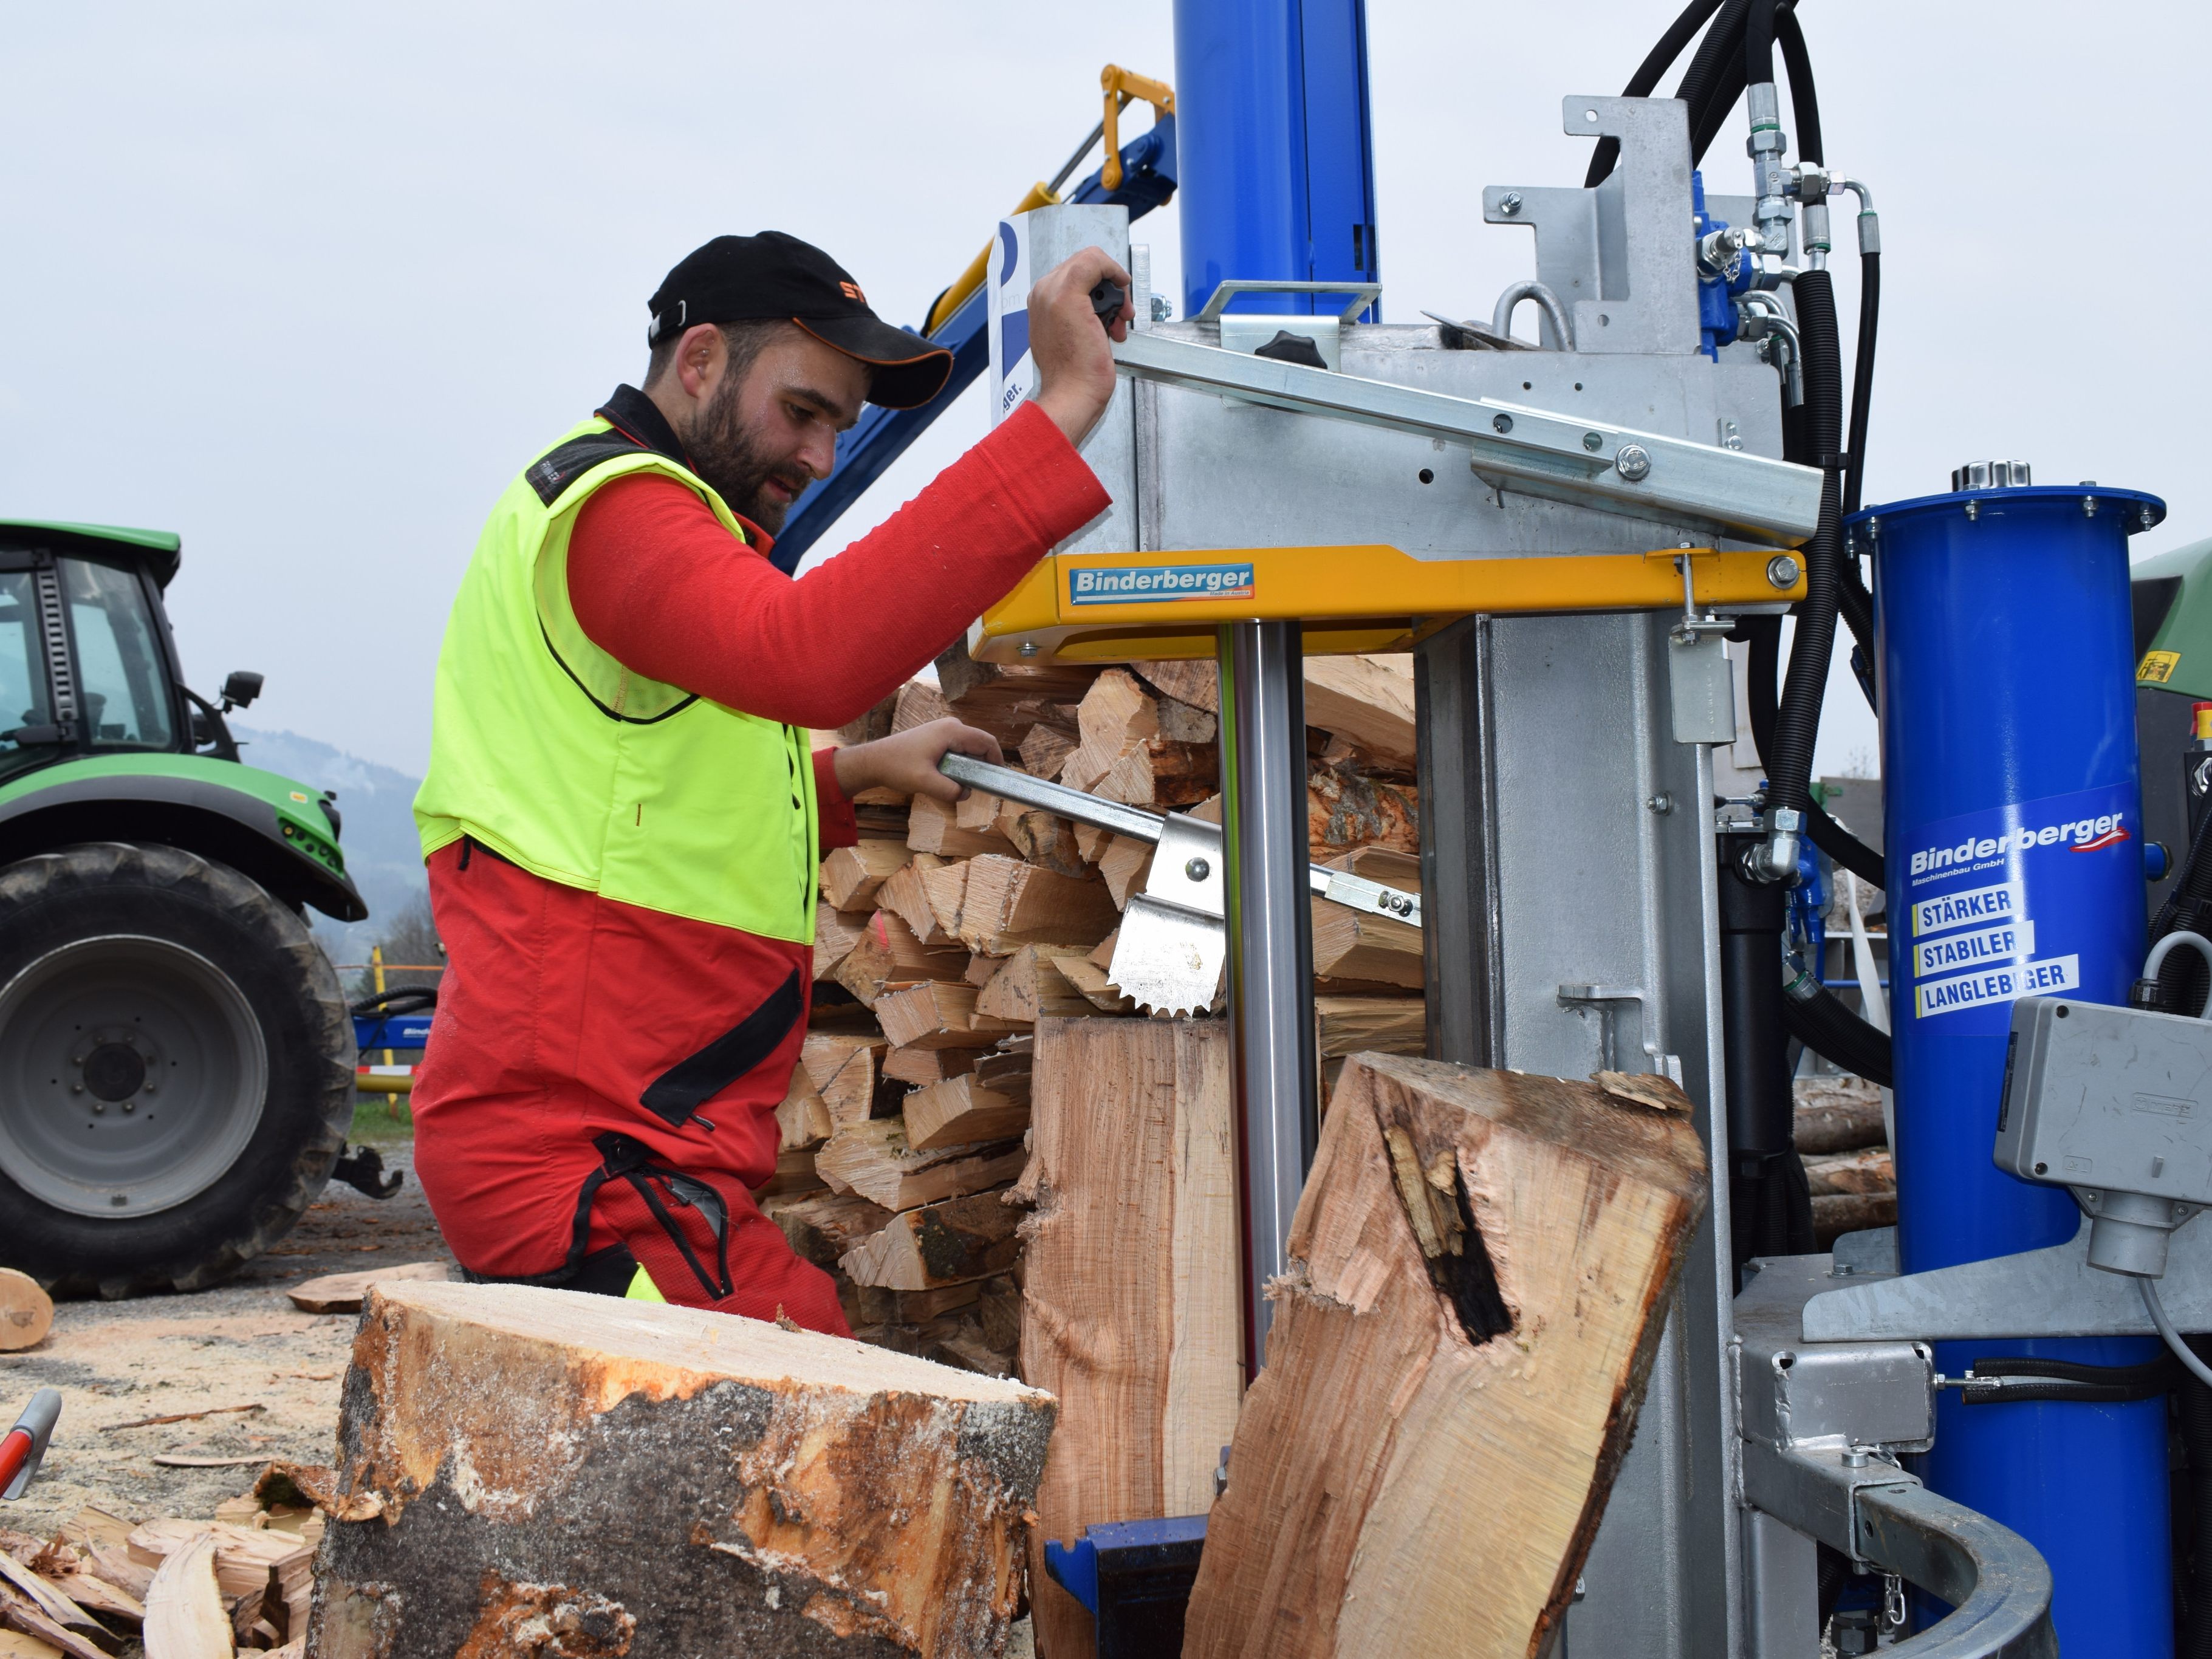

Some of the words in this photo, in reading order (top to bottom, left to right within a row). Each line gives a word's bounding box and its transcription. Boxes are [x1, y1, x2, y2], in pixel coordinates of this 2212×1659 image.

[1077, 570, 1250, 591] Binderberger
[1911, 812, 2123, 875] Binderberger
[1912, 866, 1971, 887] Maschinenbau
[1973, 858, 2005, 871] GmbH
[1922, 889, 2012, 928] STÄRKER
[1923, 930, 2019, 968] STABILER
[1925, 964, 2066, 1009] LANGLEBIGER
